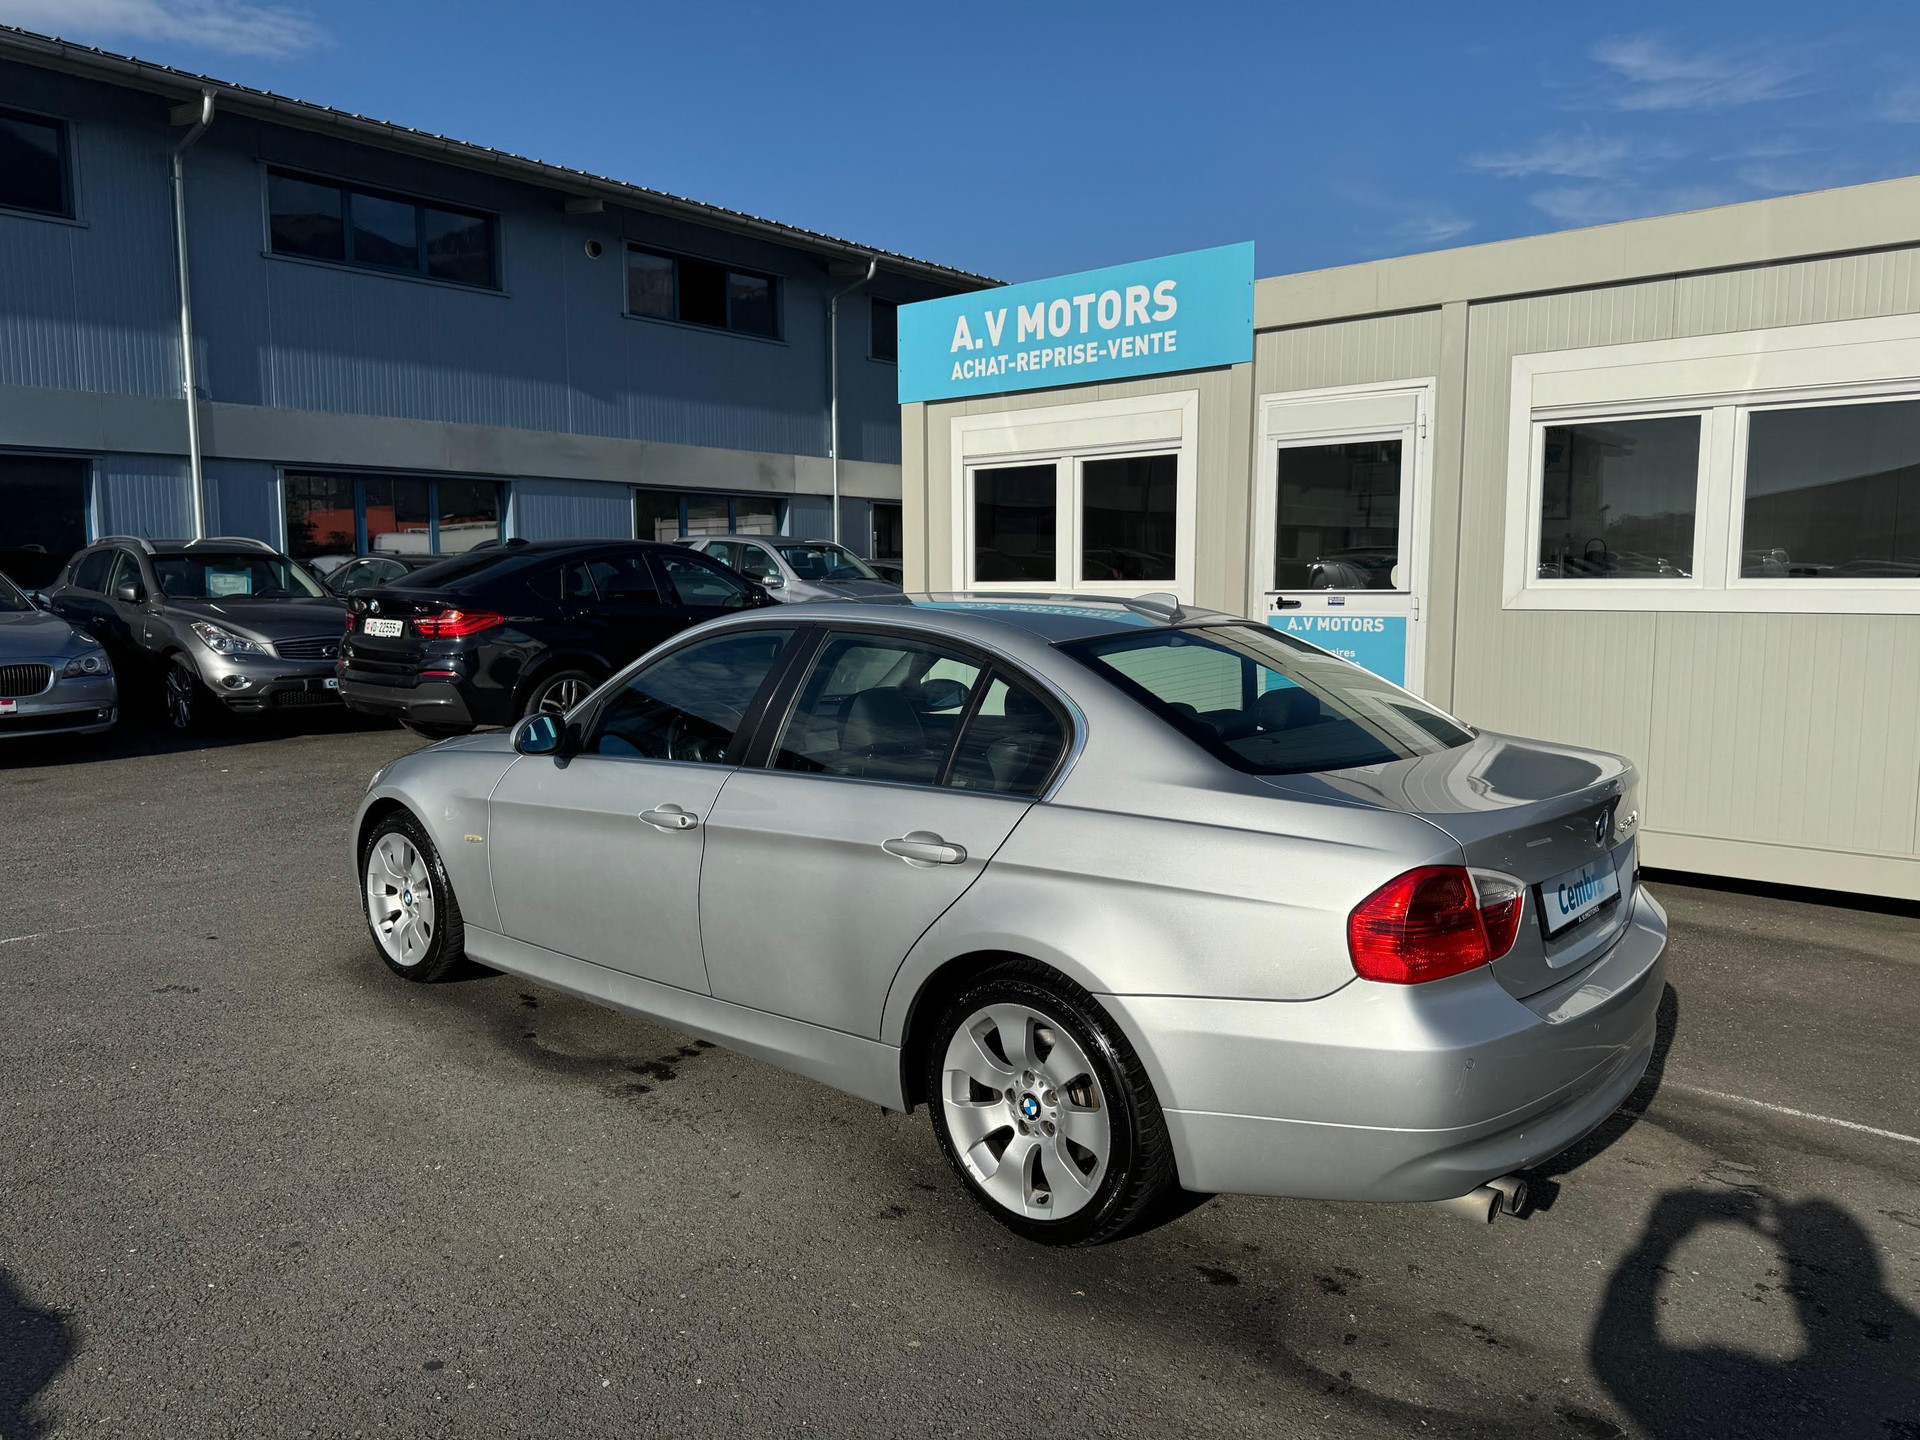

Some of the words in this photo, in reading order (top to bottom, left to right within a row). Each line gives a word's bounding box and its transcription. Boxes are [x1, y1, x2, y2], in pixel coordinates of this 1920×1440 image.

[950, 309, 1006, 352] A.V
[1017, 280, 1178, 342] MOTORS
[951, 330, 1178, 381] ACHAT-REPRISE-VENTE
[1287, 617, 1313, 631] A.V
[1317, 617, 1384, 632] MOTORS
[1558, 868, 1605, 915] Cembra
